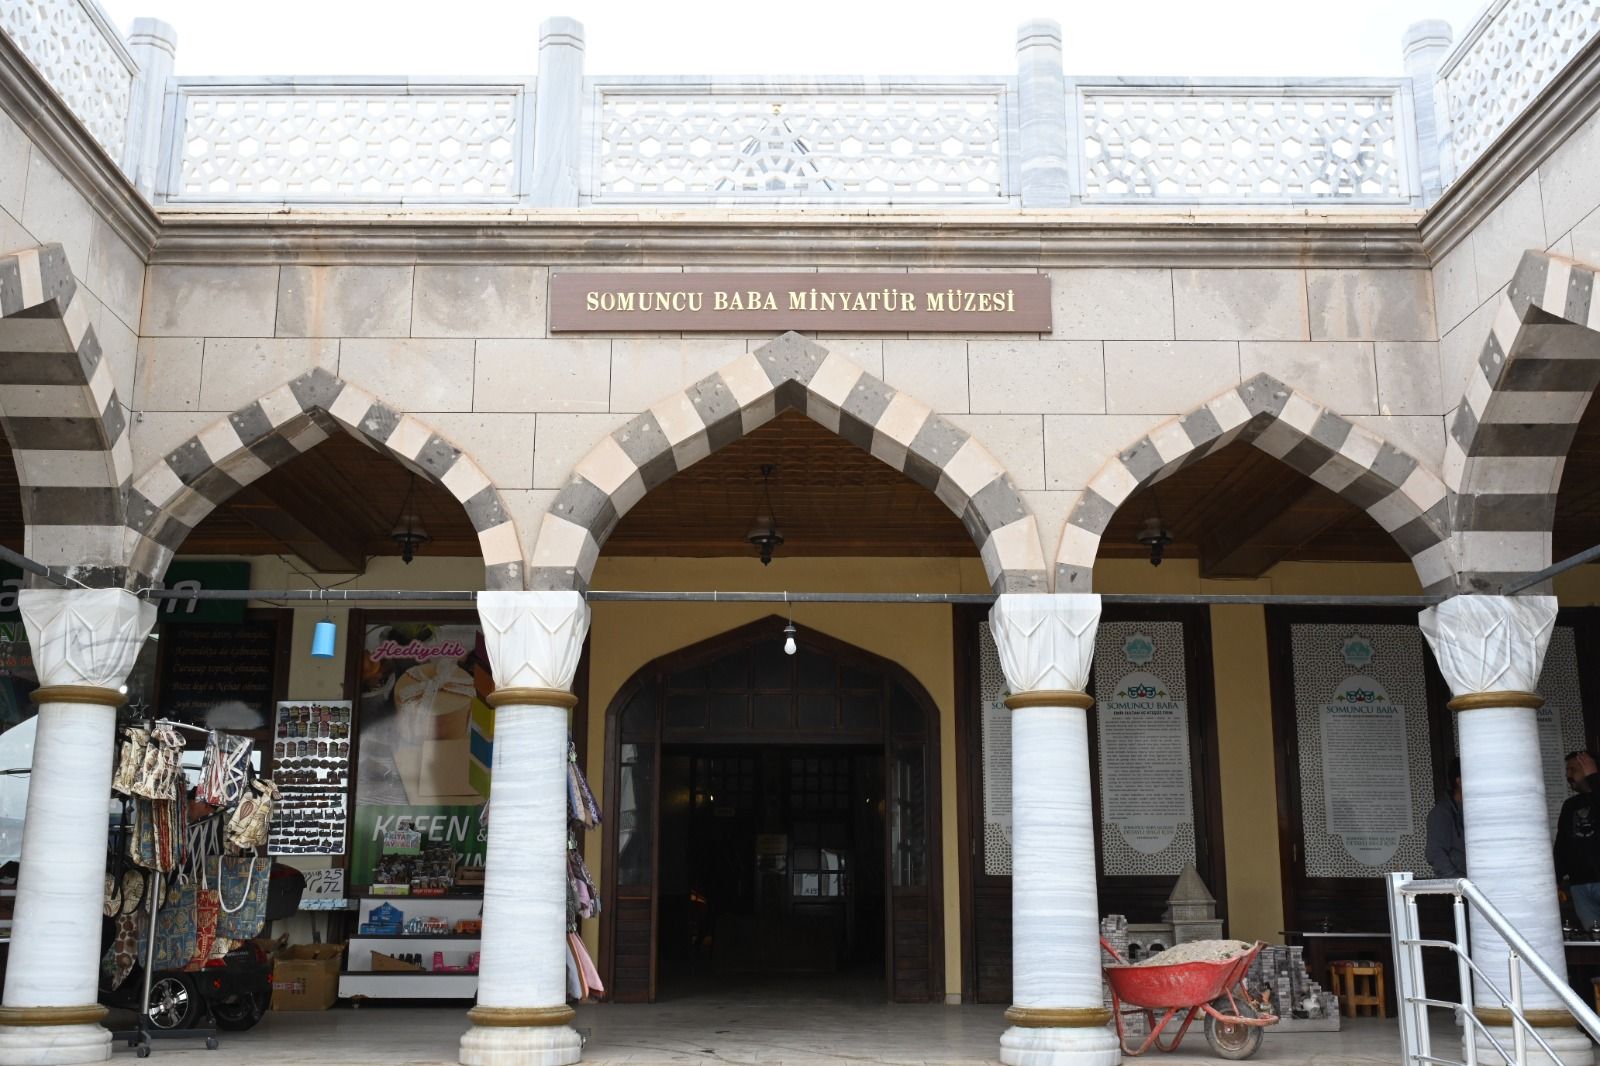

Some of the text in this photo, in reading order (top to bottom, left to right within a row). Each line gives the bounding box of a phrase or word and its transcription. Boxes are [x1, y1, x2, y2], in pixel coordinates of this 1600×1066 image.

[586, 288, 1016, 313] SOMUNCU BABA MİNYATÜR MÜZESİ
[371, 640, 465, 661] Hediyelik
[1106, 701, 1179, 709] SOMUNCU BABA
[1326, 705, 1398, 714] SOMUNCU BABA
[324, 869, 342, 880] 25
[323, 881, 341, 893] TL
